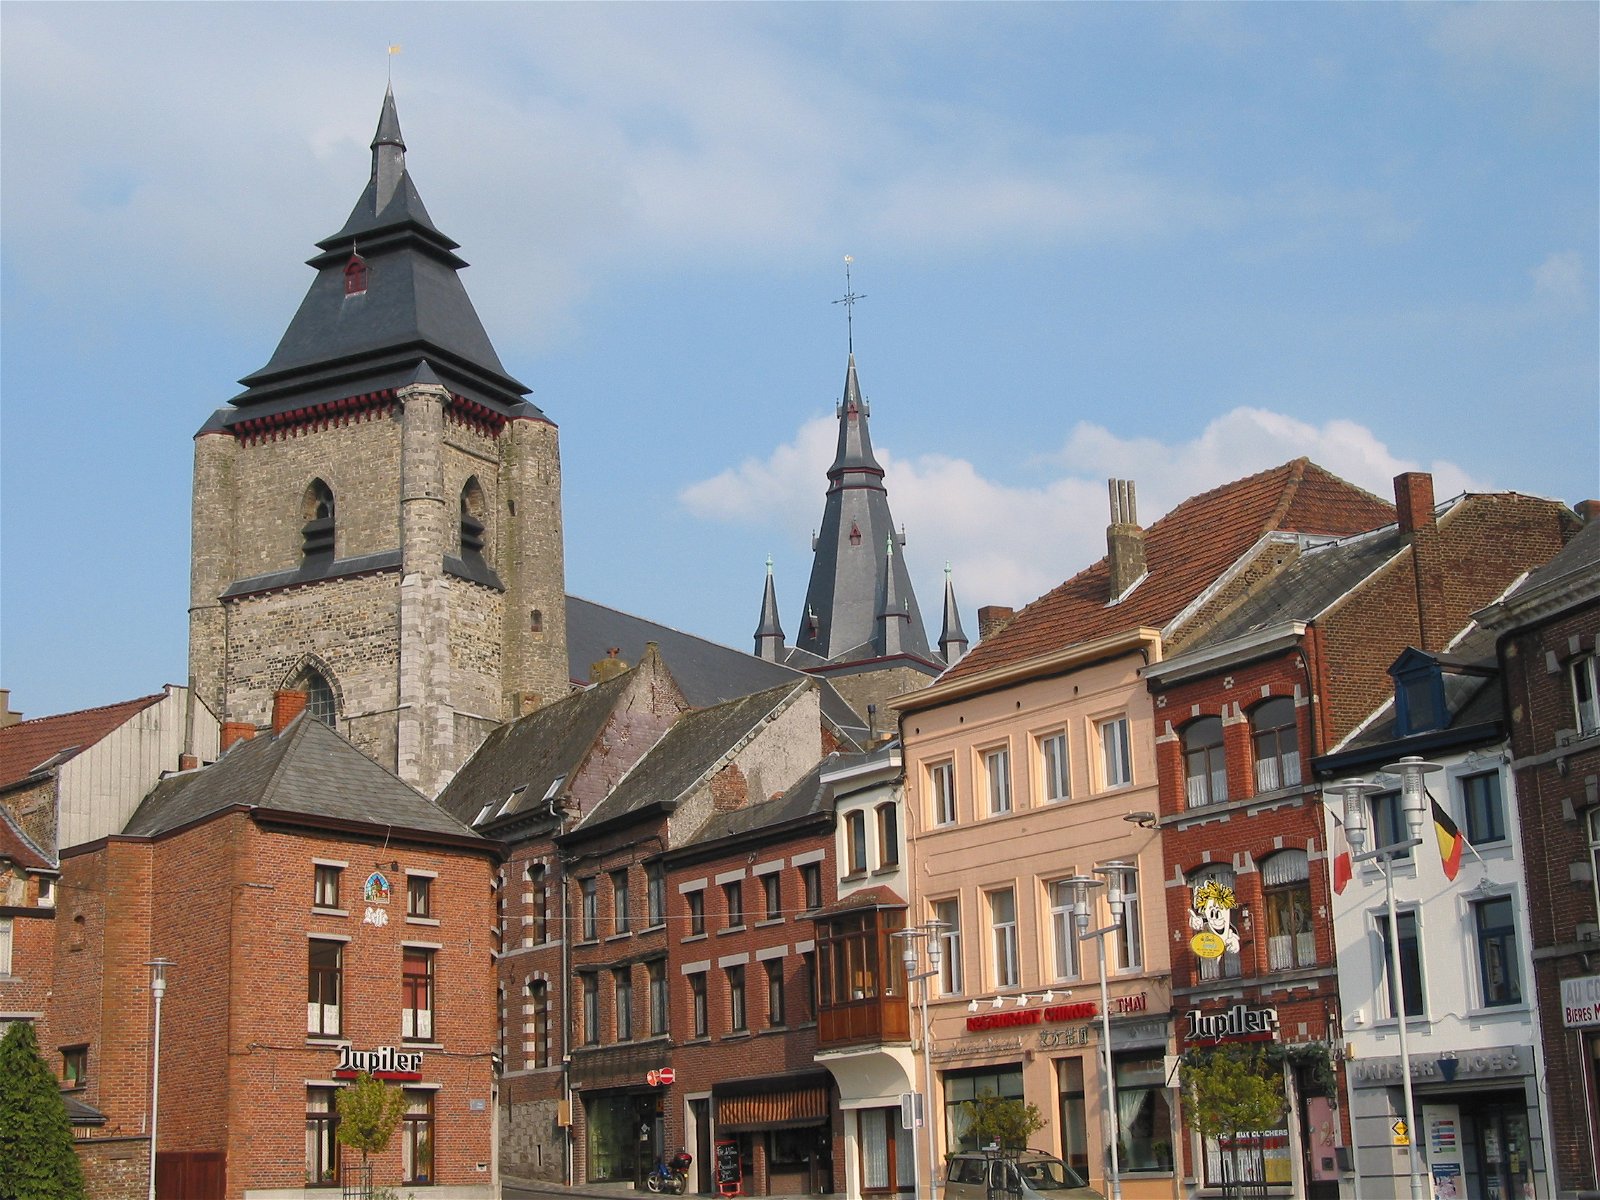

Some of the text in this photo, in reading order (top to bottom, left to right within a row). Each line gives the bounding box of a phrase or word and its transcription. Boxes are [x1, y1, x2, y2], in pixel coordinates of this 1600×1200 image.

[966, 1008, 1042, 1032] RESTAURANT
[1184, 1005, 1277, 1044] Jupiler
[335, 1045, 423, 1075] Jupiler
